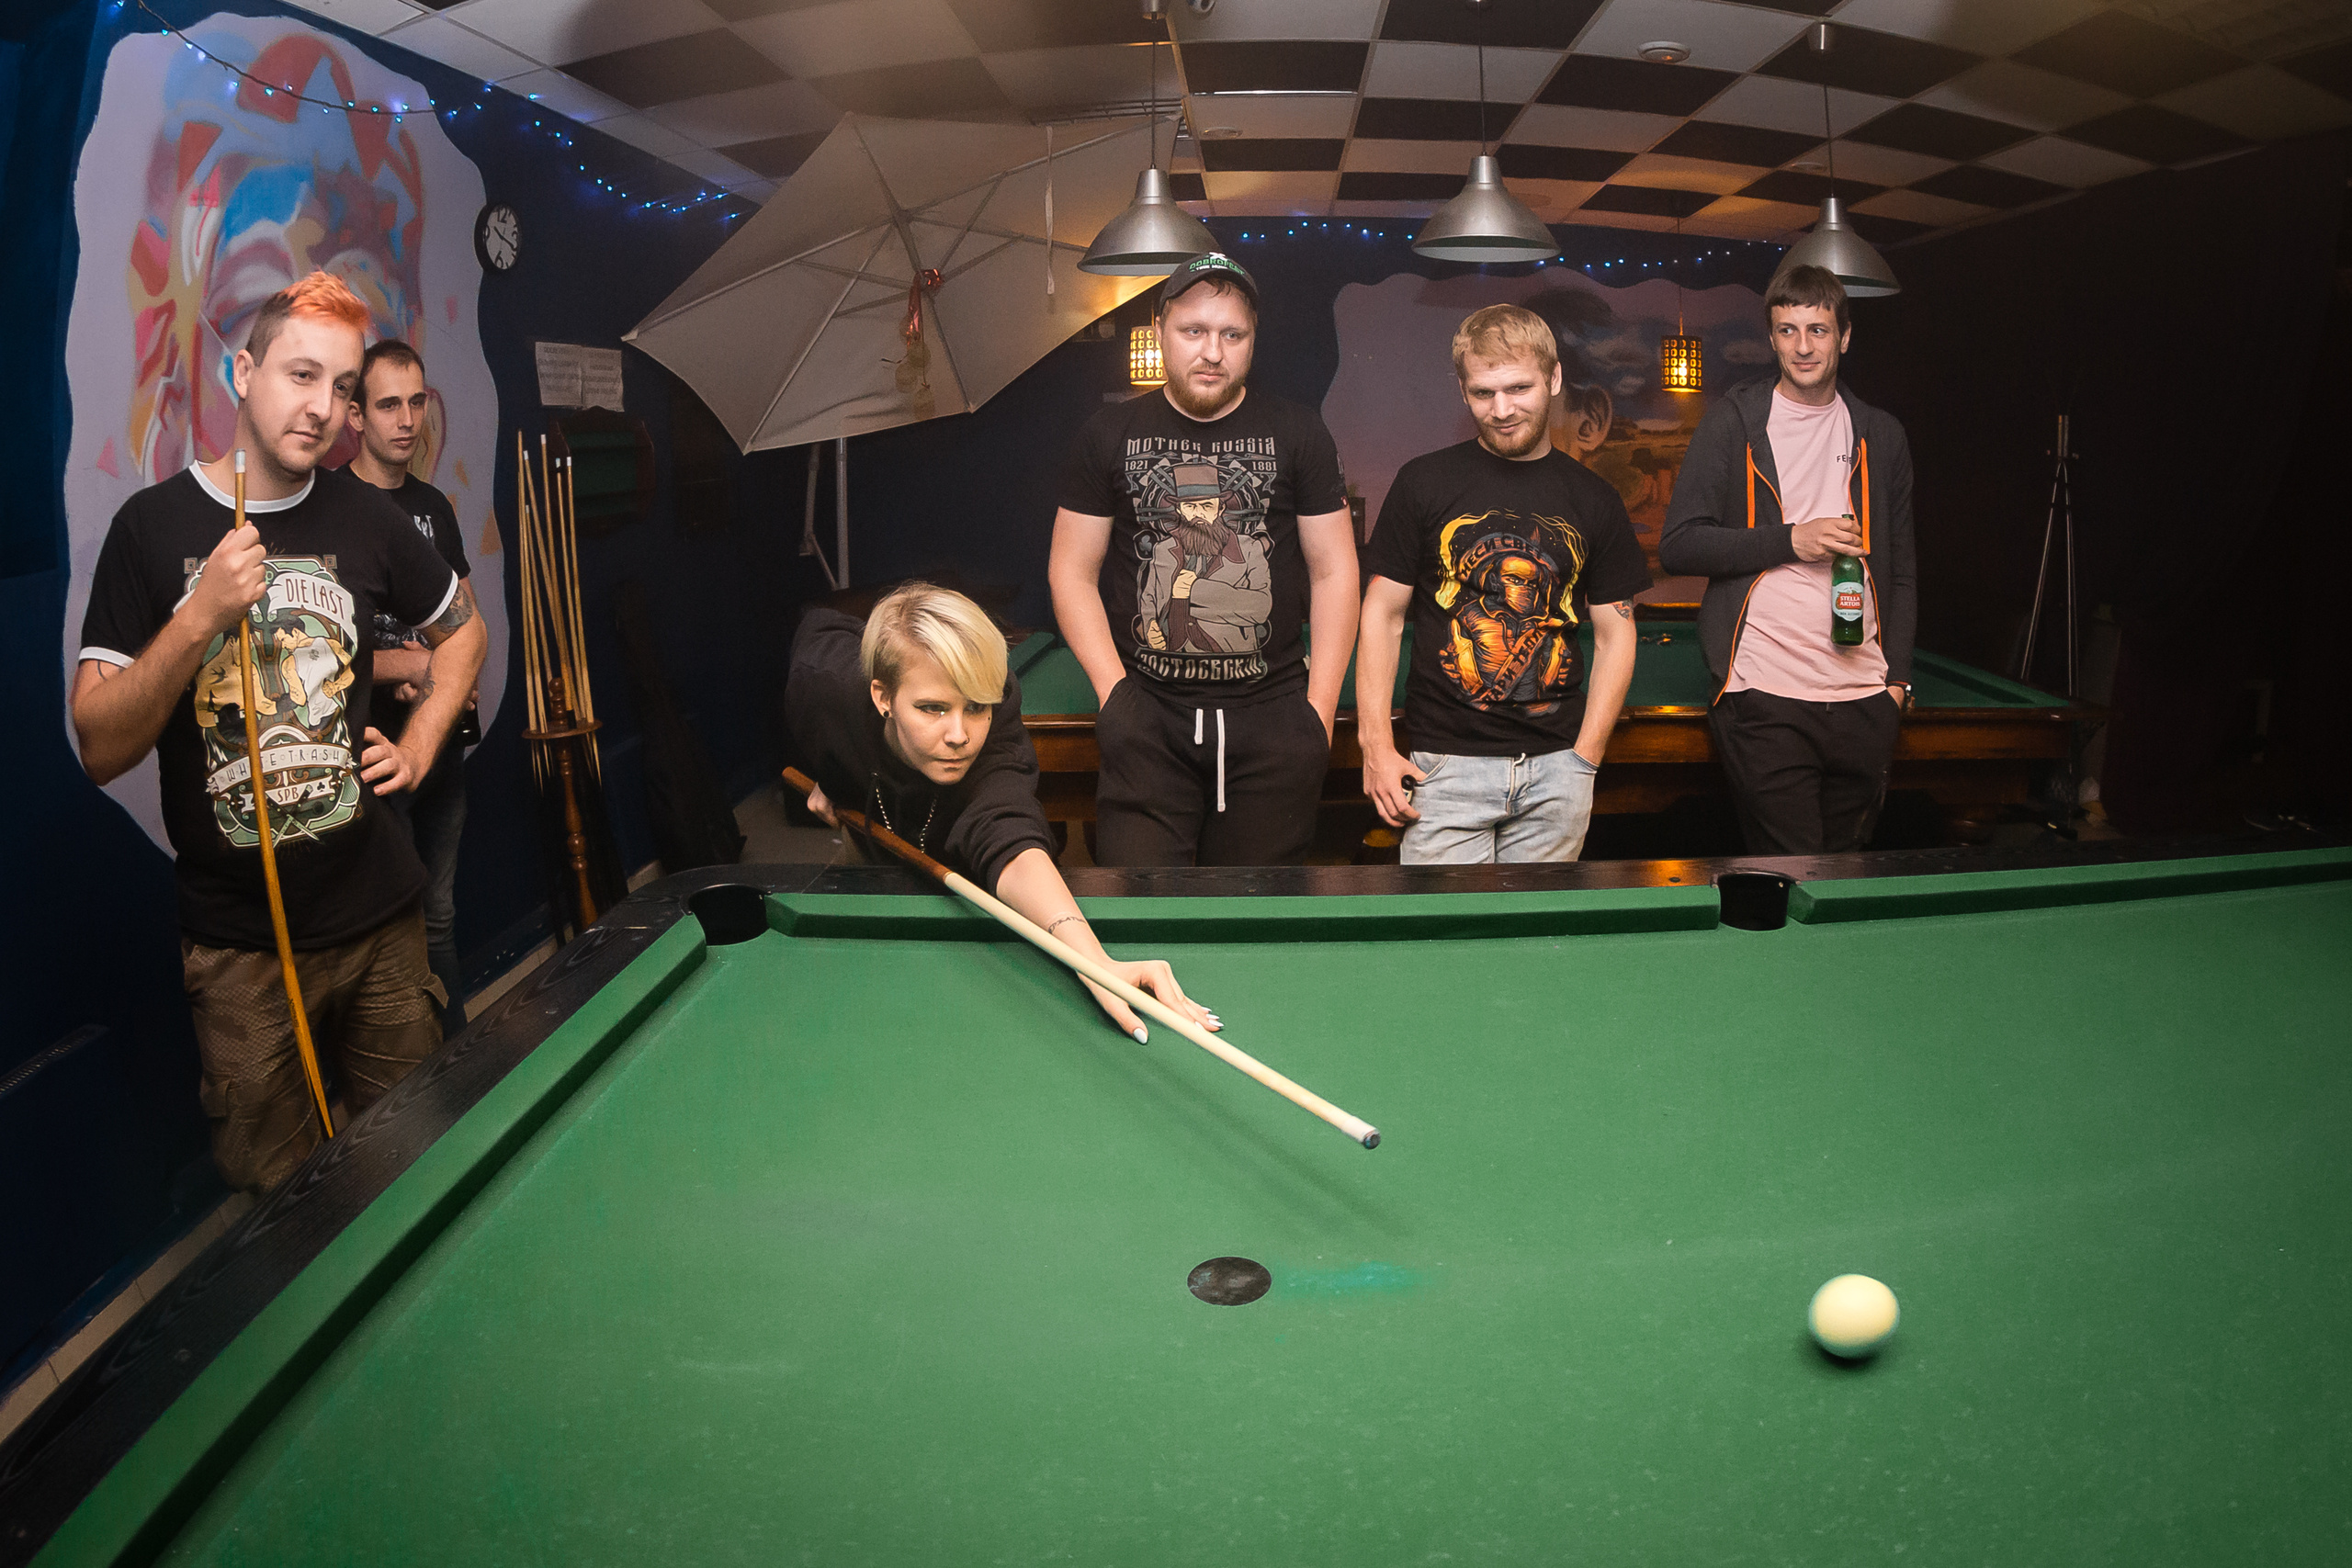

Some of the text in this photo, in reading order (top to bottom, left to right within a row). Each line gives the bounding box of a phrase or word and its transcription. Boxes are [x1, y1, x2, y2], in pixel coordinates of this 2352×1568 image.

[1126, 436, 1201, 457] MOTHER
[1125, 460, 1148, 471] 1821
[1252, 461, 1277, 471] 1881
[1461, 537, 1496, 577] НЕСИ
[285, 578, 345, 619] DIE LAST
[1512, 630, 1544, 666] ТЕПЛ
[226, 749, 340, 782] WHE TRASH
[277, 786, 300, 803] SPB
